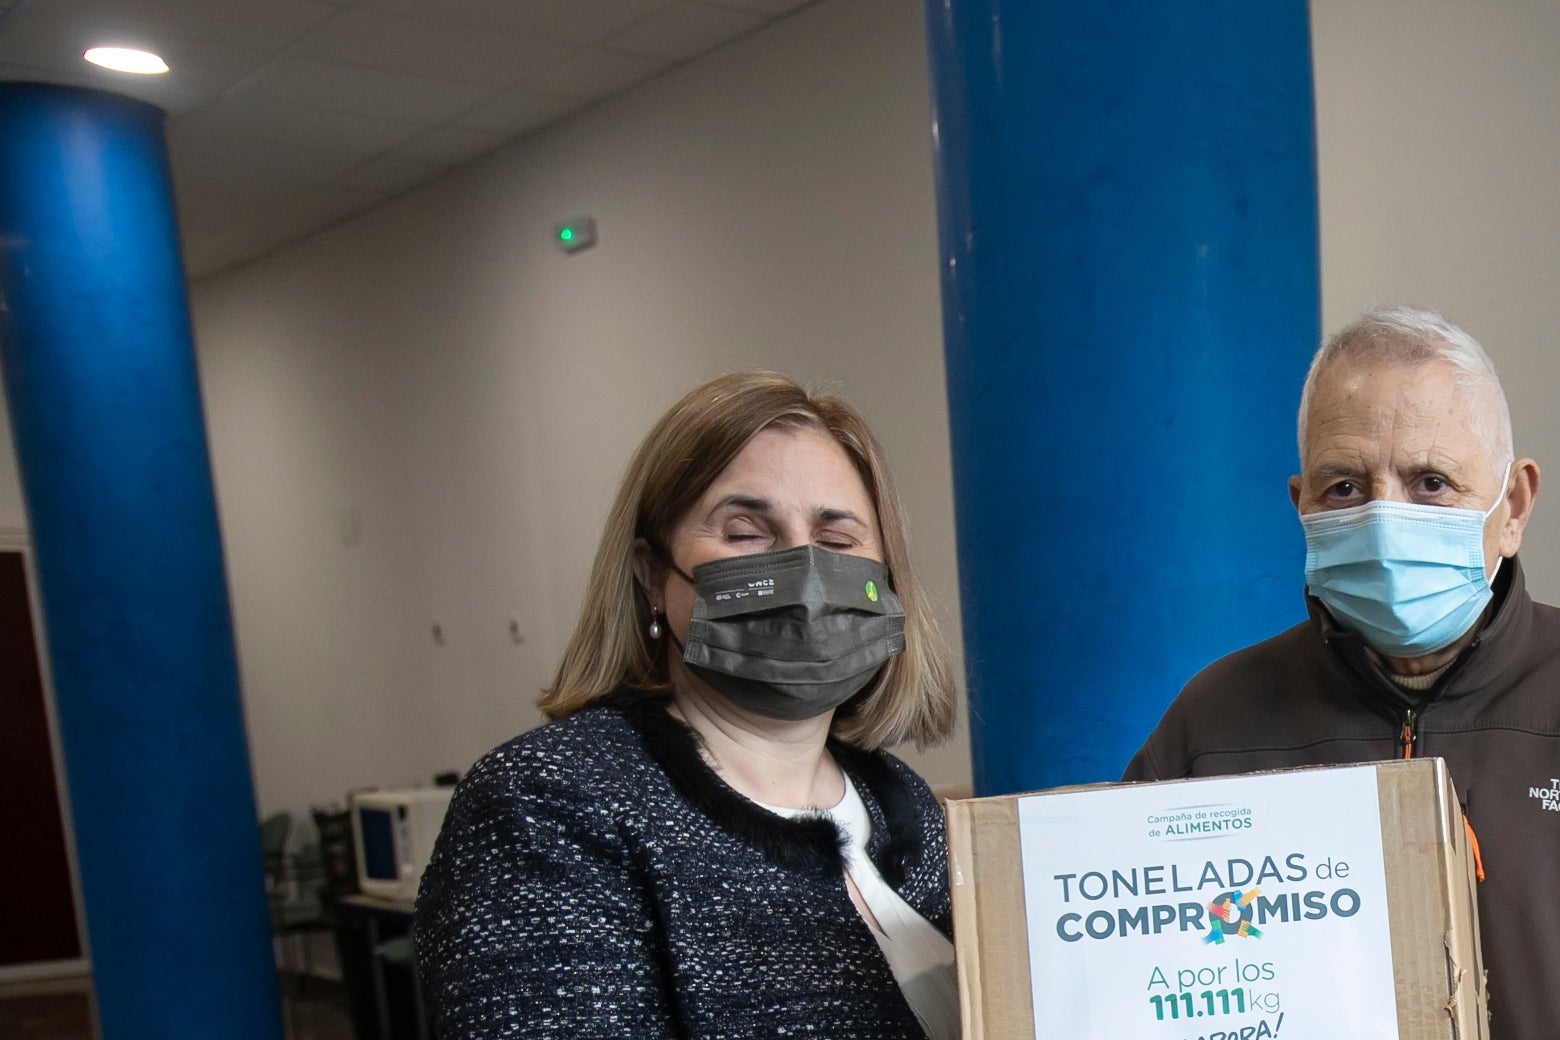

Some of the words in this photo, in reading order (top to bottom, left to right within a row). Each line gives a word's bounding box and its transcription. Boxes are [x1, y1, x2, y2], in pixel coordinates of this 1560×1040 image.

[1147, 811, 1192, 825] Campaña
[1194, 810, 1207, 820] de
[1209, 807, 1252, 820] recogida
[1148, 828, 1161, 838] de
[1165, 817, 1252, 836] ALIMENTOS
[1054, 853, 1308, 903] TONELADAS
[1315, 857, 1350, 880] de
[1056, 888, 1361, 943] COMPROMISO
[1147, 966, 1170, 991] A
[1178, 966, 1227, 993] por
[1236, 958, 1275, 983] los
[1149, 987, 1245, 1020] 111.111
[1249, 988, 1280, 1014] kg
